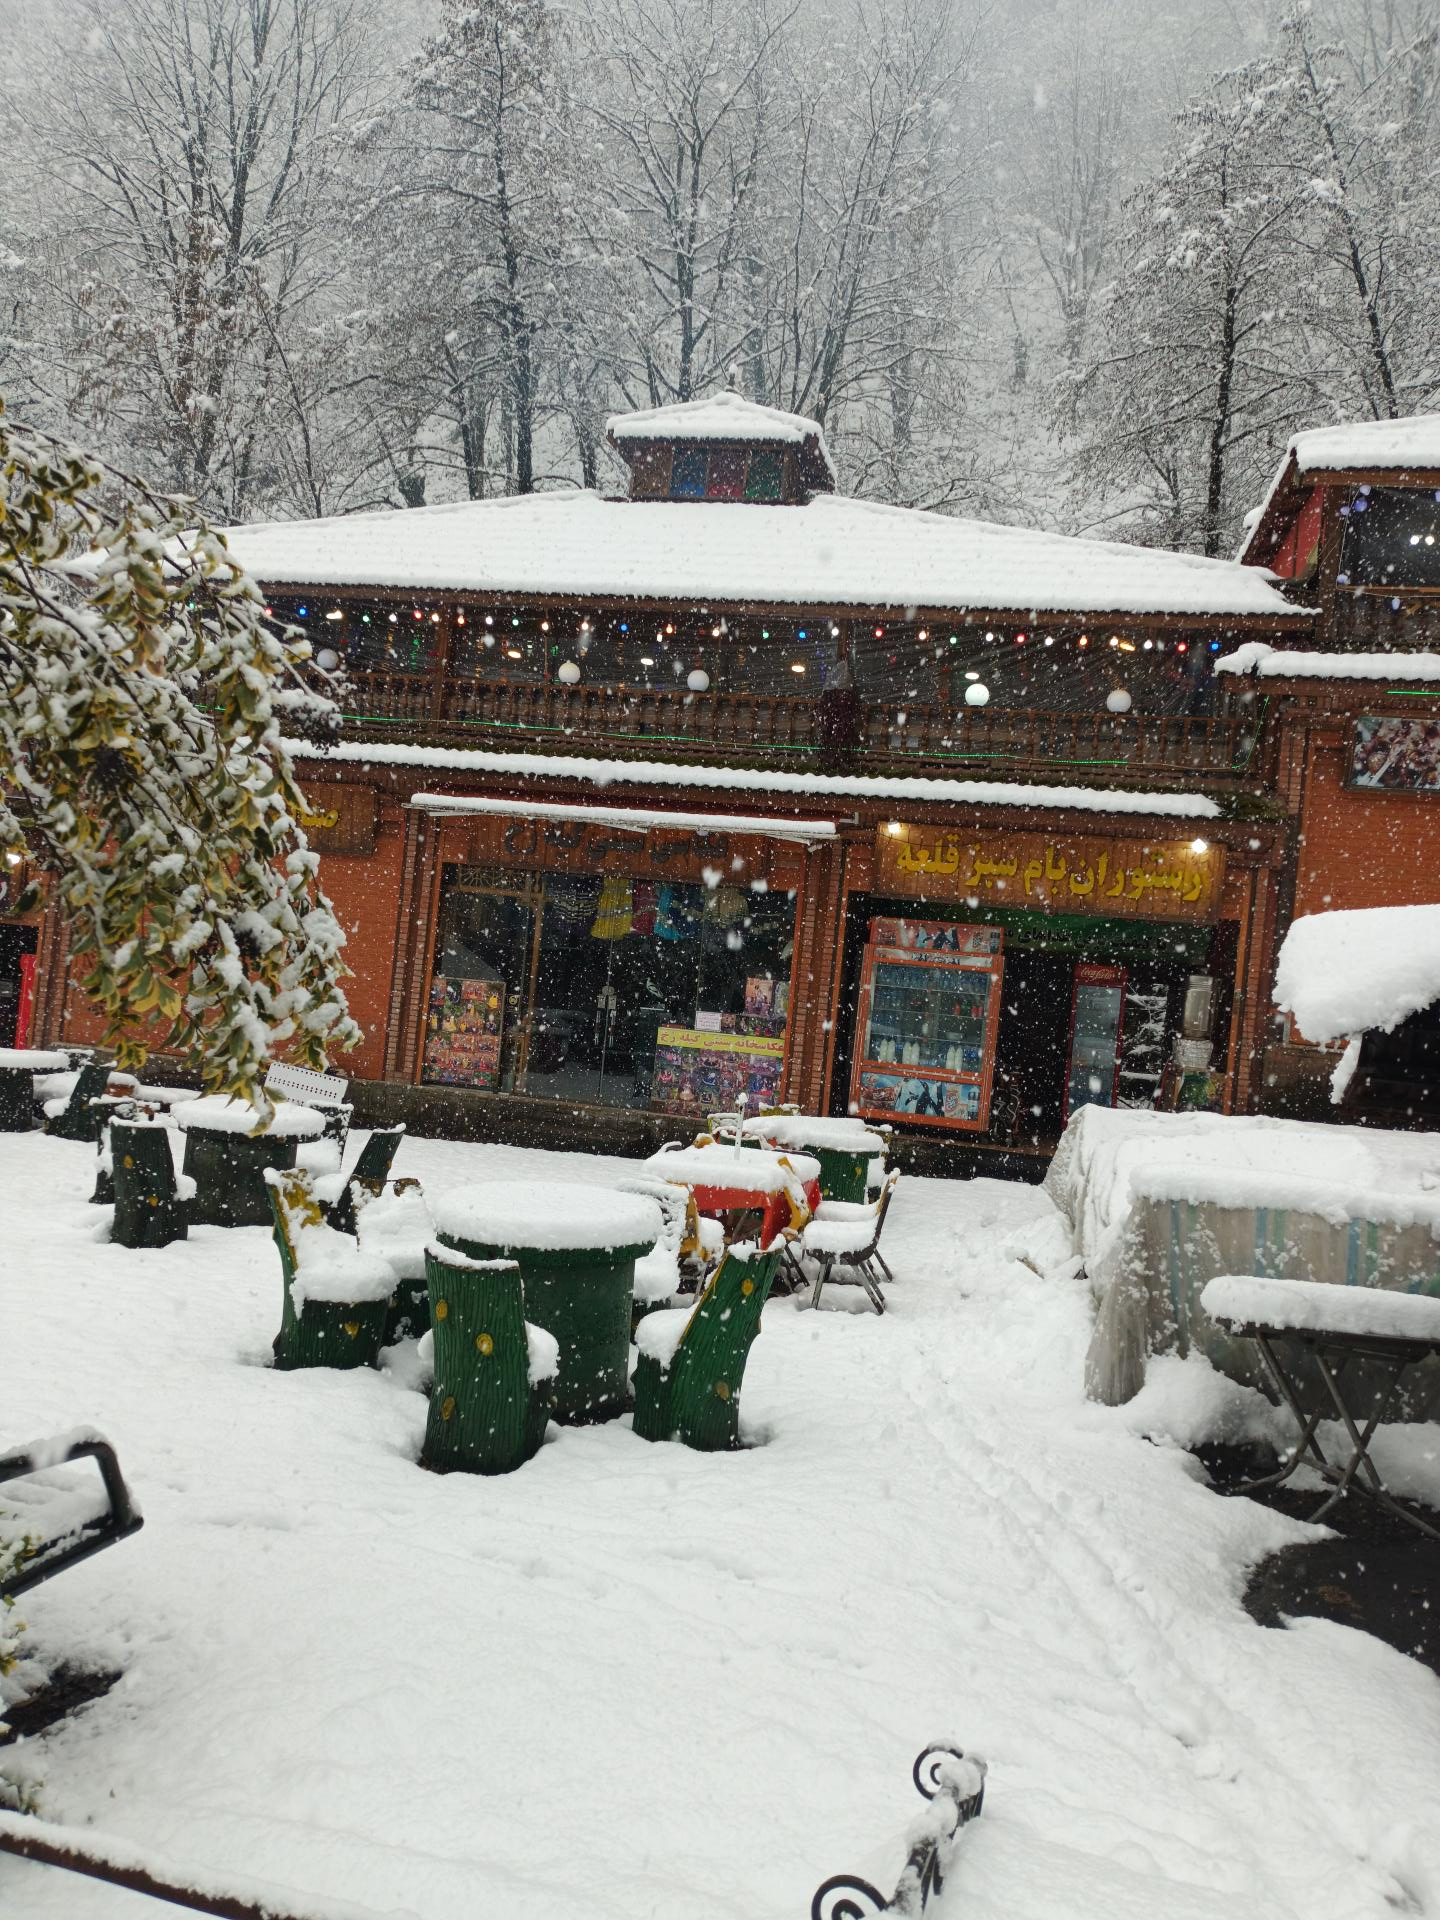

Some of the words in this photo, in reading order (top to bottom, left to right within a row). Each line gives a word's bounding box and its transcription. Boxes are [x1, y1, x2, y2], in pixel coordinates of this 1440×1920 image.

[897, 834, 960, 874] قلعه
[963, 843, 1018, 888] سبز
[1024, 843, 1066, 895] بام
[1068, 850, 1204, 900] رستوران
